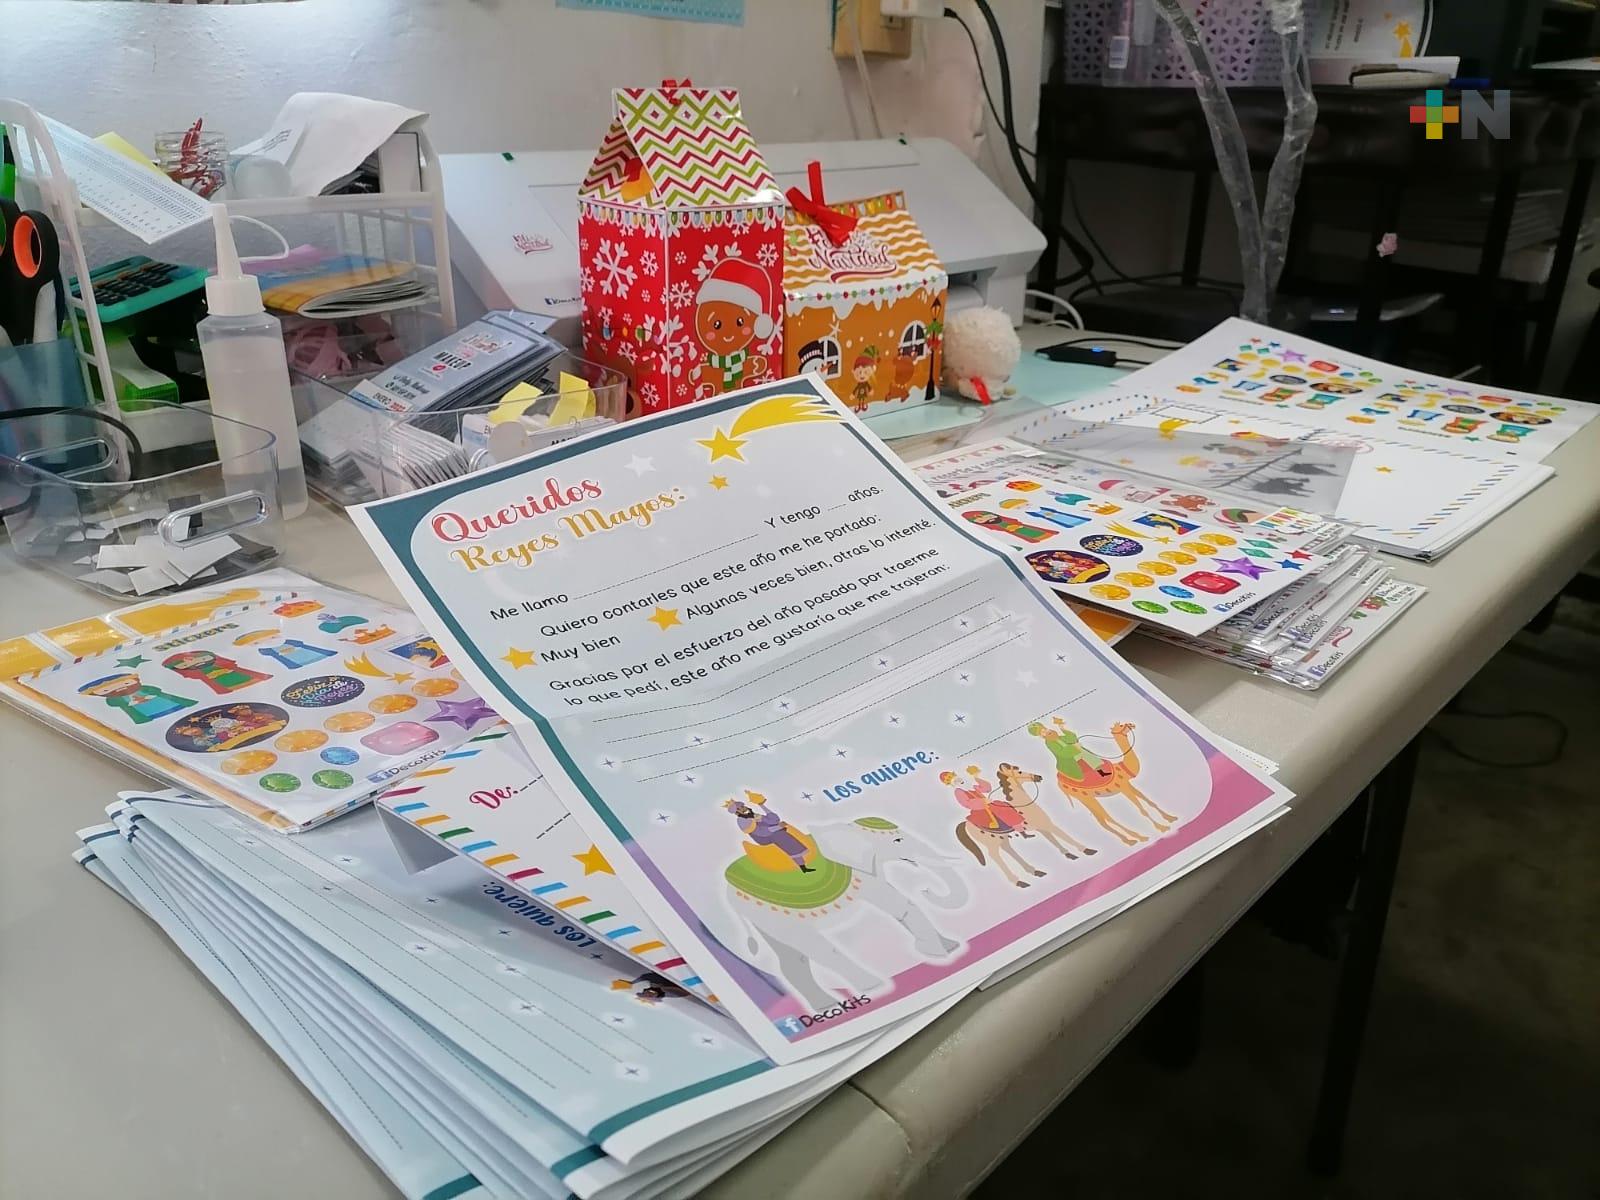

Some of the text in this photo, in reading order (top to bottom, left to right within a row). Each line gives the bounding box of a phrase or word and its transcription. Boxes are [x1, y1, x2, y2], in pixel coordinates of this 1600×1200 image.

[808, 245, 891, 272] Navidad
[432, 478, 601, 541] Queridos
[450, 488, 685, 571] Reyes Magos:
[490, 484, 884, 621] Me llamo Y tengo años.
[540, 514, 882, 637] Quiero contarles que este año me he portado:
[686, 519, 937, 620] Algunas veces bien, otras lo intenté.
[152, 622, 239, 651] stickers
[540, 634, 621, 663] Muy bien
[549, 548, 940, 691] Gracias por el esfuerzo del año pasado por traerme
[563, 563, 951, 707] lo que pedí, este año me gustaría que me trajeran:
[861, 751, 940, 785] quiere:
[482, 881, 555, 928] quiere:
[799, 994, 872, 1028] DecoKits
